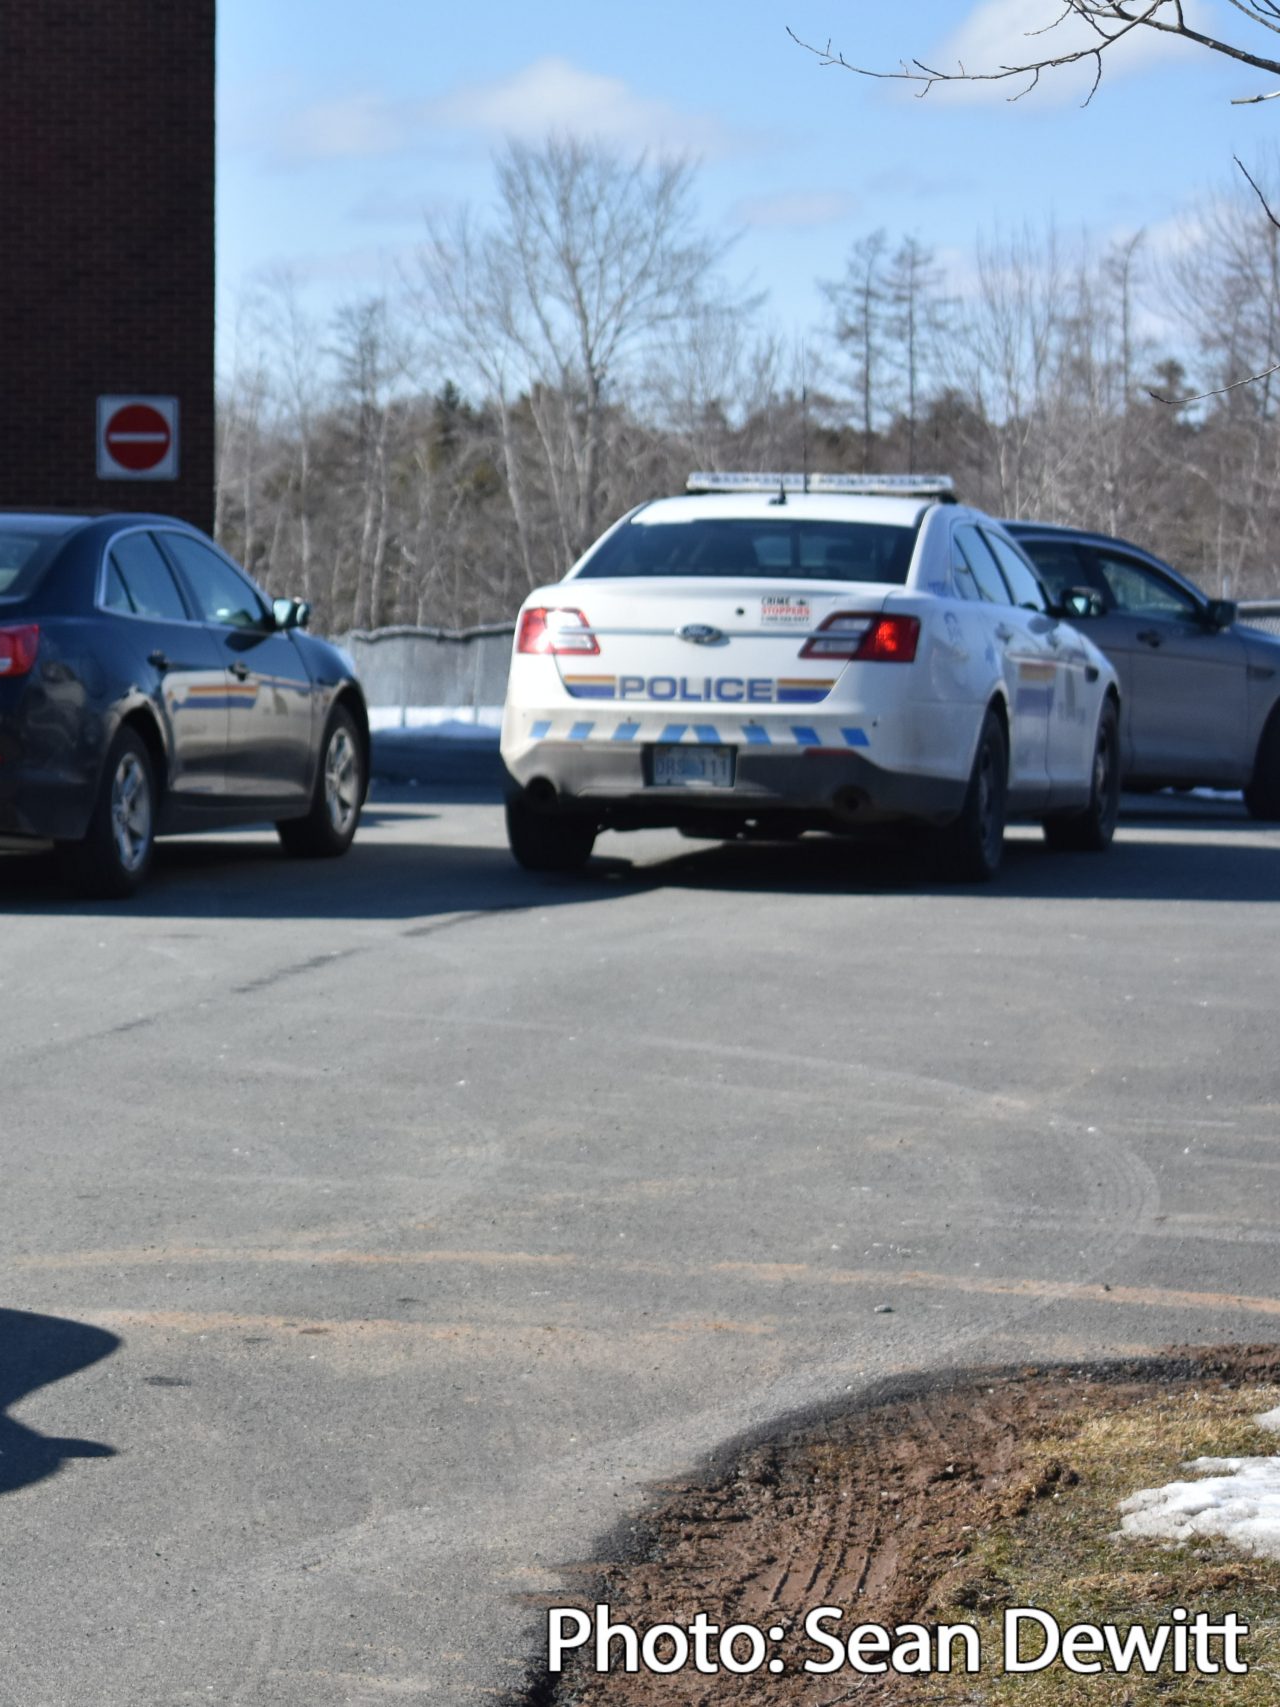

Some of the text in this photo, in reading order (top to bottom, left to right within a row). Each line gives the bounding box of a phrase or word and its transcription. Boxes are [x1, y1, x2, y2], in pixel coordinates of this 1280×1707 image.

[761, 596, 790, 606] CRIME
[761, 606, 810, 616] STOPPERS
[621, 676, 773, 702] POLICE
